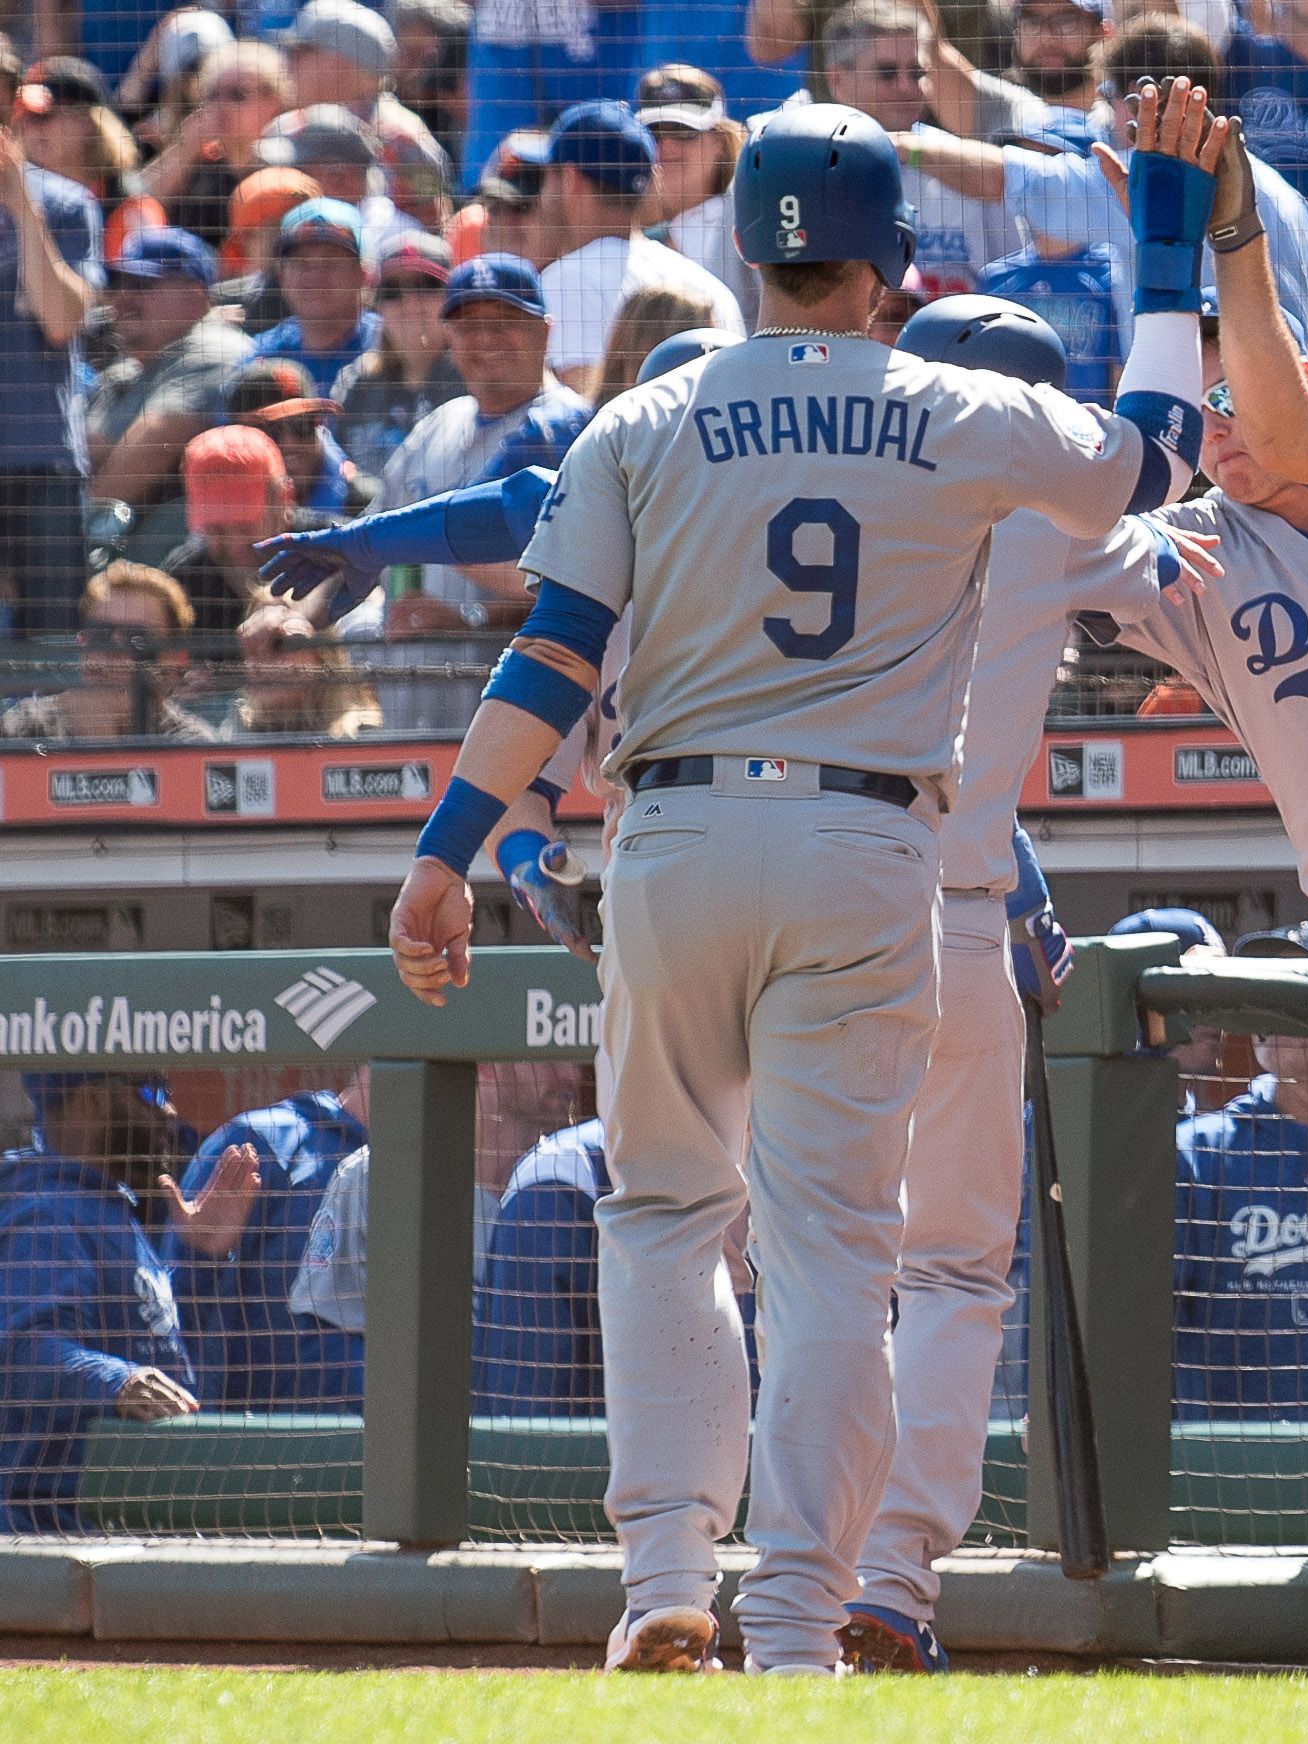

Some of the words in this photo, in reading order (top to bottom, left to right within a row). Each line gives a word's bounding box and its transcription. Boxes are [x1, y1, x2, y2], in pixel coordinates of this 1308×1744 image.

[779, 195, 800, 230] 9
[693, 396, 937, 472] GRANDAL
[763, 497, 860, 660] 9
[60, 996, 104, 1054] of
[104, 995, 267, 1053] America
[526, 988, 601, 1048] Ban
